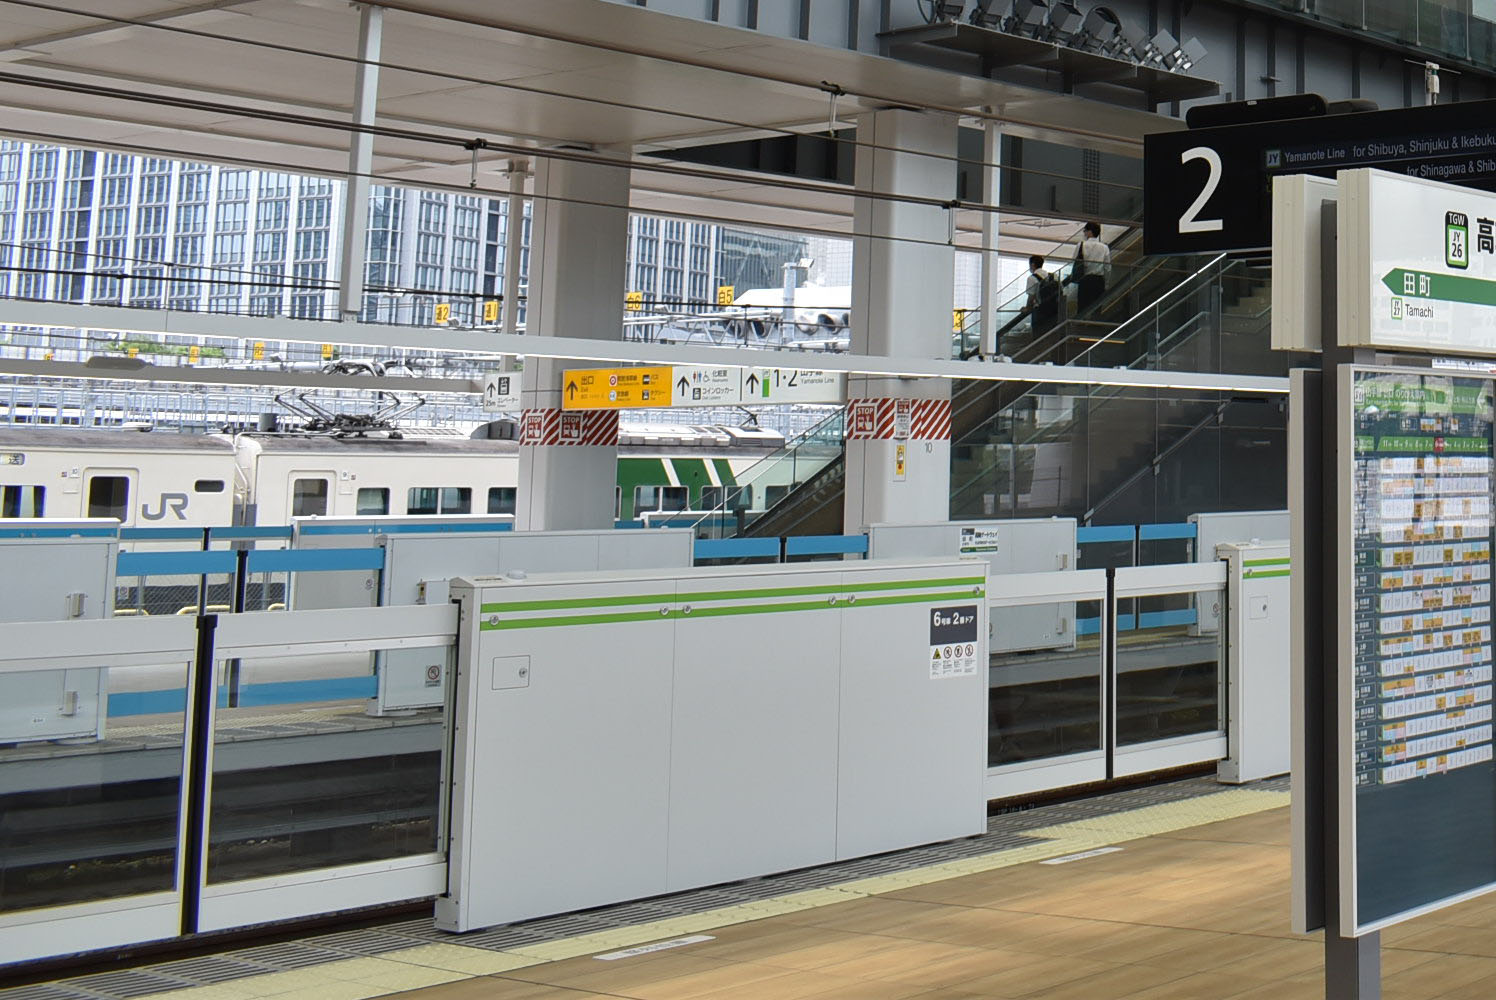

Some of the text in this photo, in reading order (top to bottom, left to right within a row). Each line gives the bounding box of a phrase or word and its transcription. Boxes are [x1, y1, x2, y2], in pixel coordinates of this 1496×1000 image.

[1267, 152, 1280, 165] JY
[1285, 150, 1325, 163] Yamanote
[1327, 147, 1345, 159] Line
[1353, 145, 1366, 157] for
[1368, 142, 1408, 157] Shibuya,
[1409, 138, 1450, 155] Shinjuku
[1451, 137, 1459, 149] &
[1407, 166, 1418, 177] for
[1420, 163, 1467, 178] Shinagawa
[1468, 162, 1475, 173] &
[1179, 147, 1223, 233] 2
[1449, 213, 1465, 226] TGW
[1453, 232, 1462, 242] JY
[1451, 243, 1463, 257] 26
[1404, 272, 1431, 297] 田町
[1405, 304, 1434, 318] Tamachi
[581, 375, 595, 385] 出口
[712, 370, 728, 378] 化粧室
[824, 376, 835, 384] Line
[702, 387, 734, 395] コインロッカー
[857, 407, 874, 415] STOP
[142, 493, 189, 520] JR
